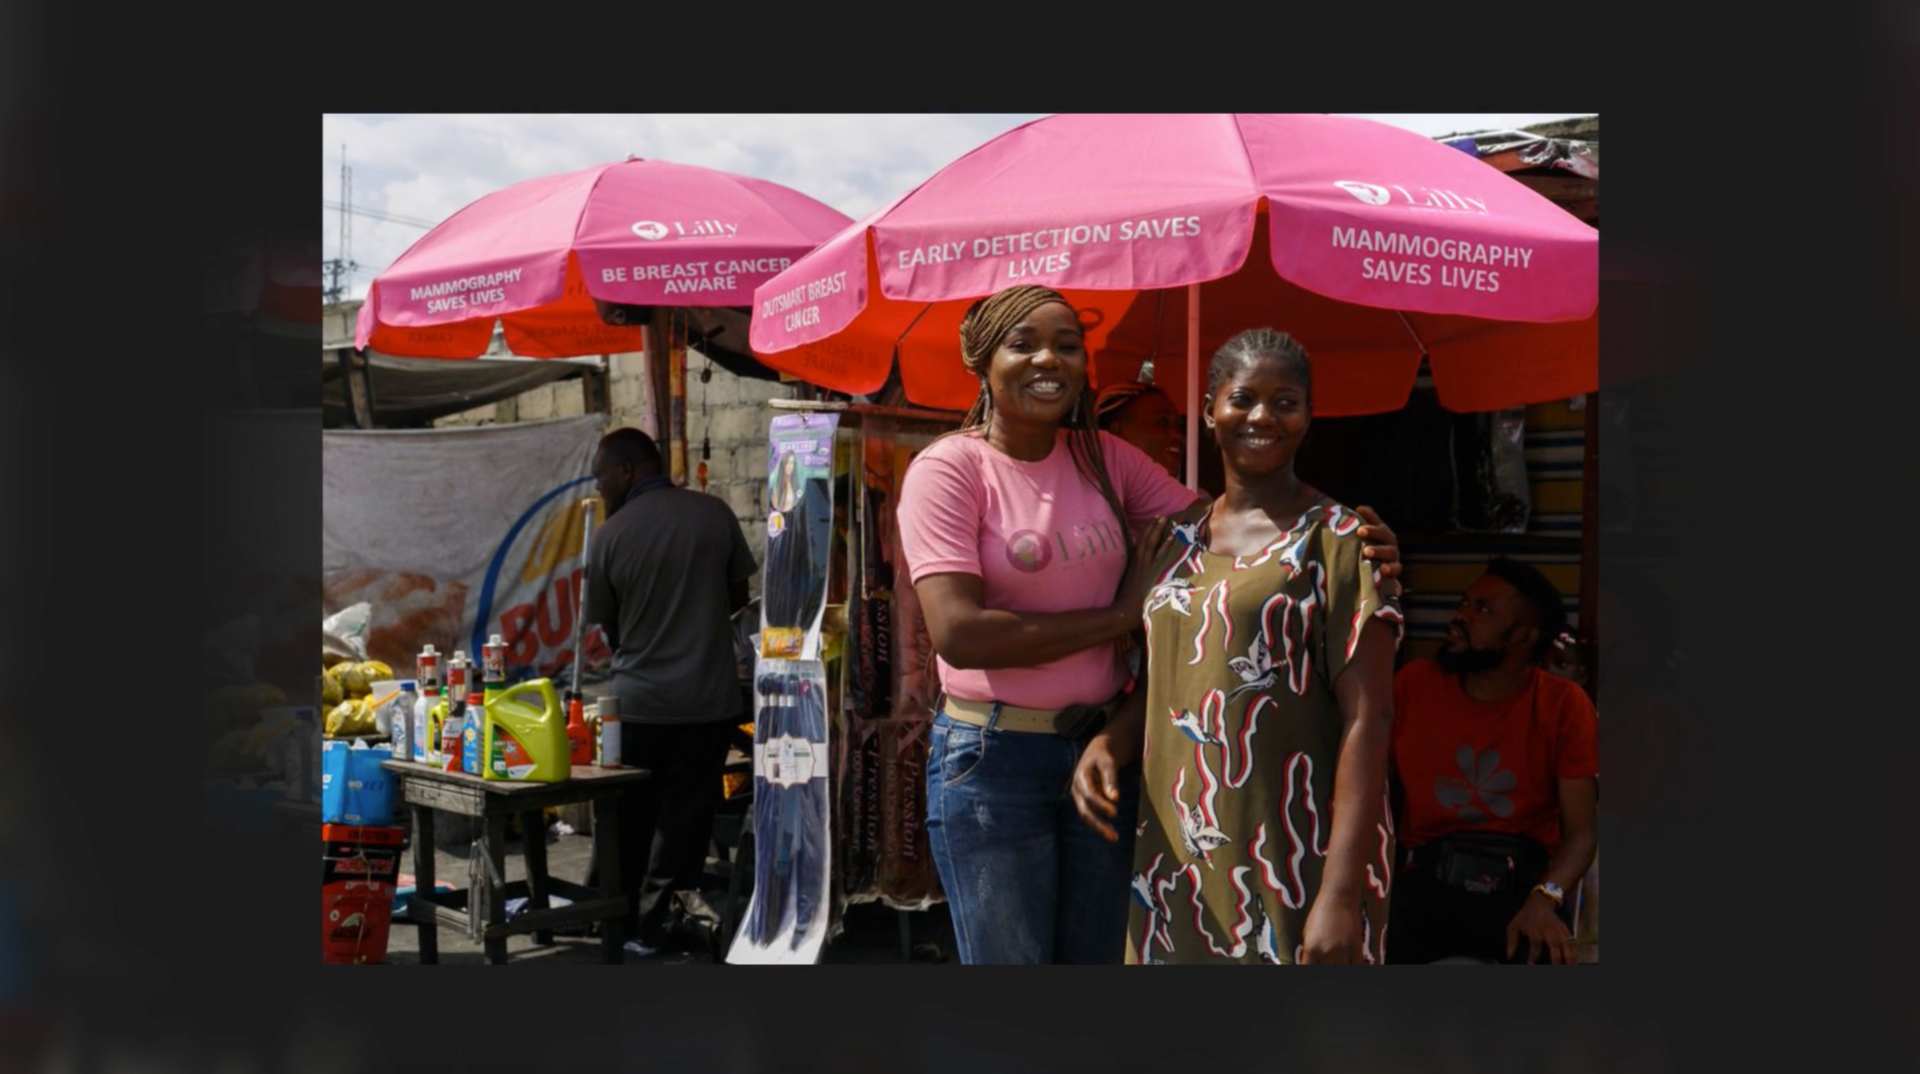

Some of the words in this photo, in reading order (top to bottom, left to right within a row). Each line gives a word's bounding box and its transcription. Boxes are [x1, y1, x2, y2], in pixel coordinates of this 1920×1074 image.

[1391, 184, 1489, 216] Lilly
[674, 219, 738, 238] Lilly
[898, 240, 967, 271] EARLY
[973, 223, 1111, 258] DETECTION
[1119, 215, 1201, 241] SAVES
[1332, 226, 1533, 269] MAMMOGRAPHY
[602, 266, 627, 283] BE
[633, 261, 709, 281] BREAST
[714, 257, 791, 276] CANCER
[1007, 251, 1072, 279] LIVES
[1362, 257, 1431, 286] SAVES
[1440, 265, 1500, 292] LIVES
[410, 267, 522, 301] MAMMOGRAPHY
[664, 274, 737, 295] AWARE
[762, 284, 806, 319] OUTSMART
[807, 271, 847, 301] BREAST
[427, 295, 466, 315] SAVES
[469, 288, 505, 306] LIVES
[784, 306, 820, 333] CANCER
